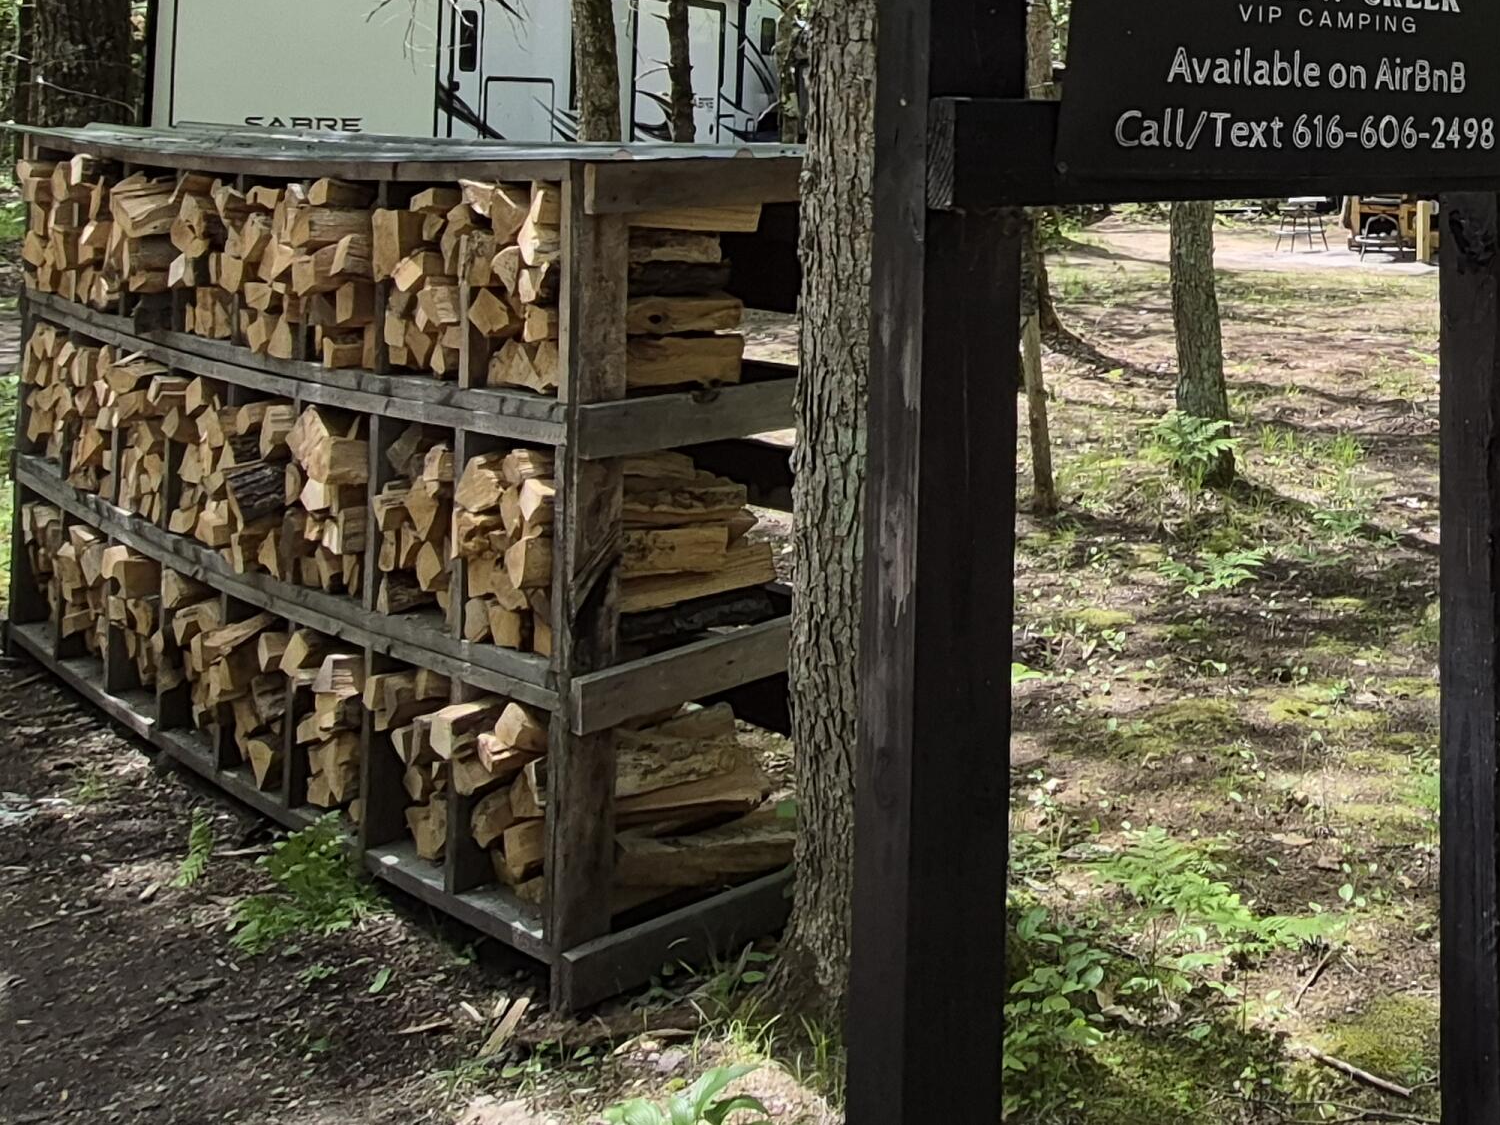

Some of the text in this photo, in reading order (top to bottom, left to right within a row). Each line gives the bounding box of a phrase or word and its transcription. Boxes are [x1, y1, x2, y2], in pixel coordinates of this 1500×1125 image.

[1239, 4, 1416, 33] VIP CAMPING
[1167, 46, 1466, 94] Available on AirBnB
[244, 116, 363, 132] SABRE
[1115, 108, 1495, 150] Call/Text 616-606-2498
